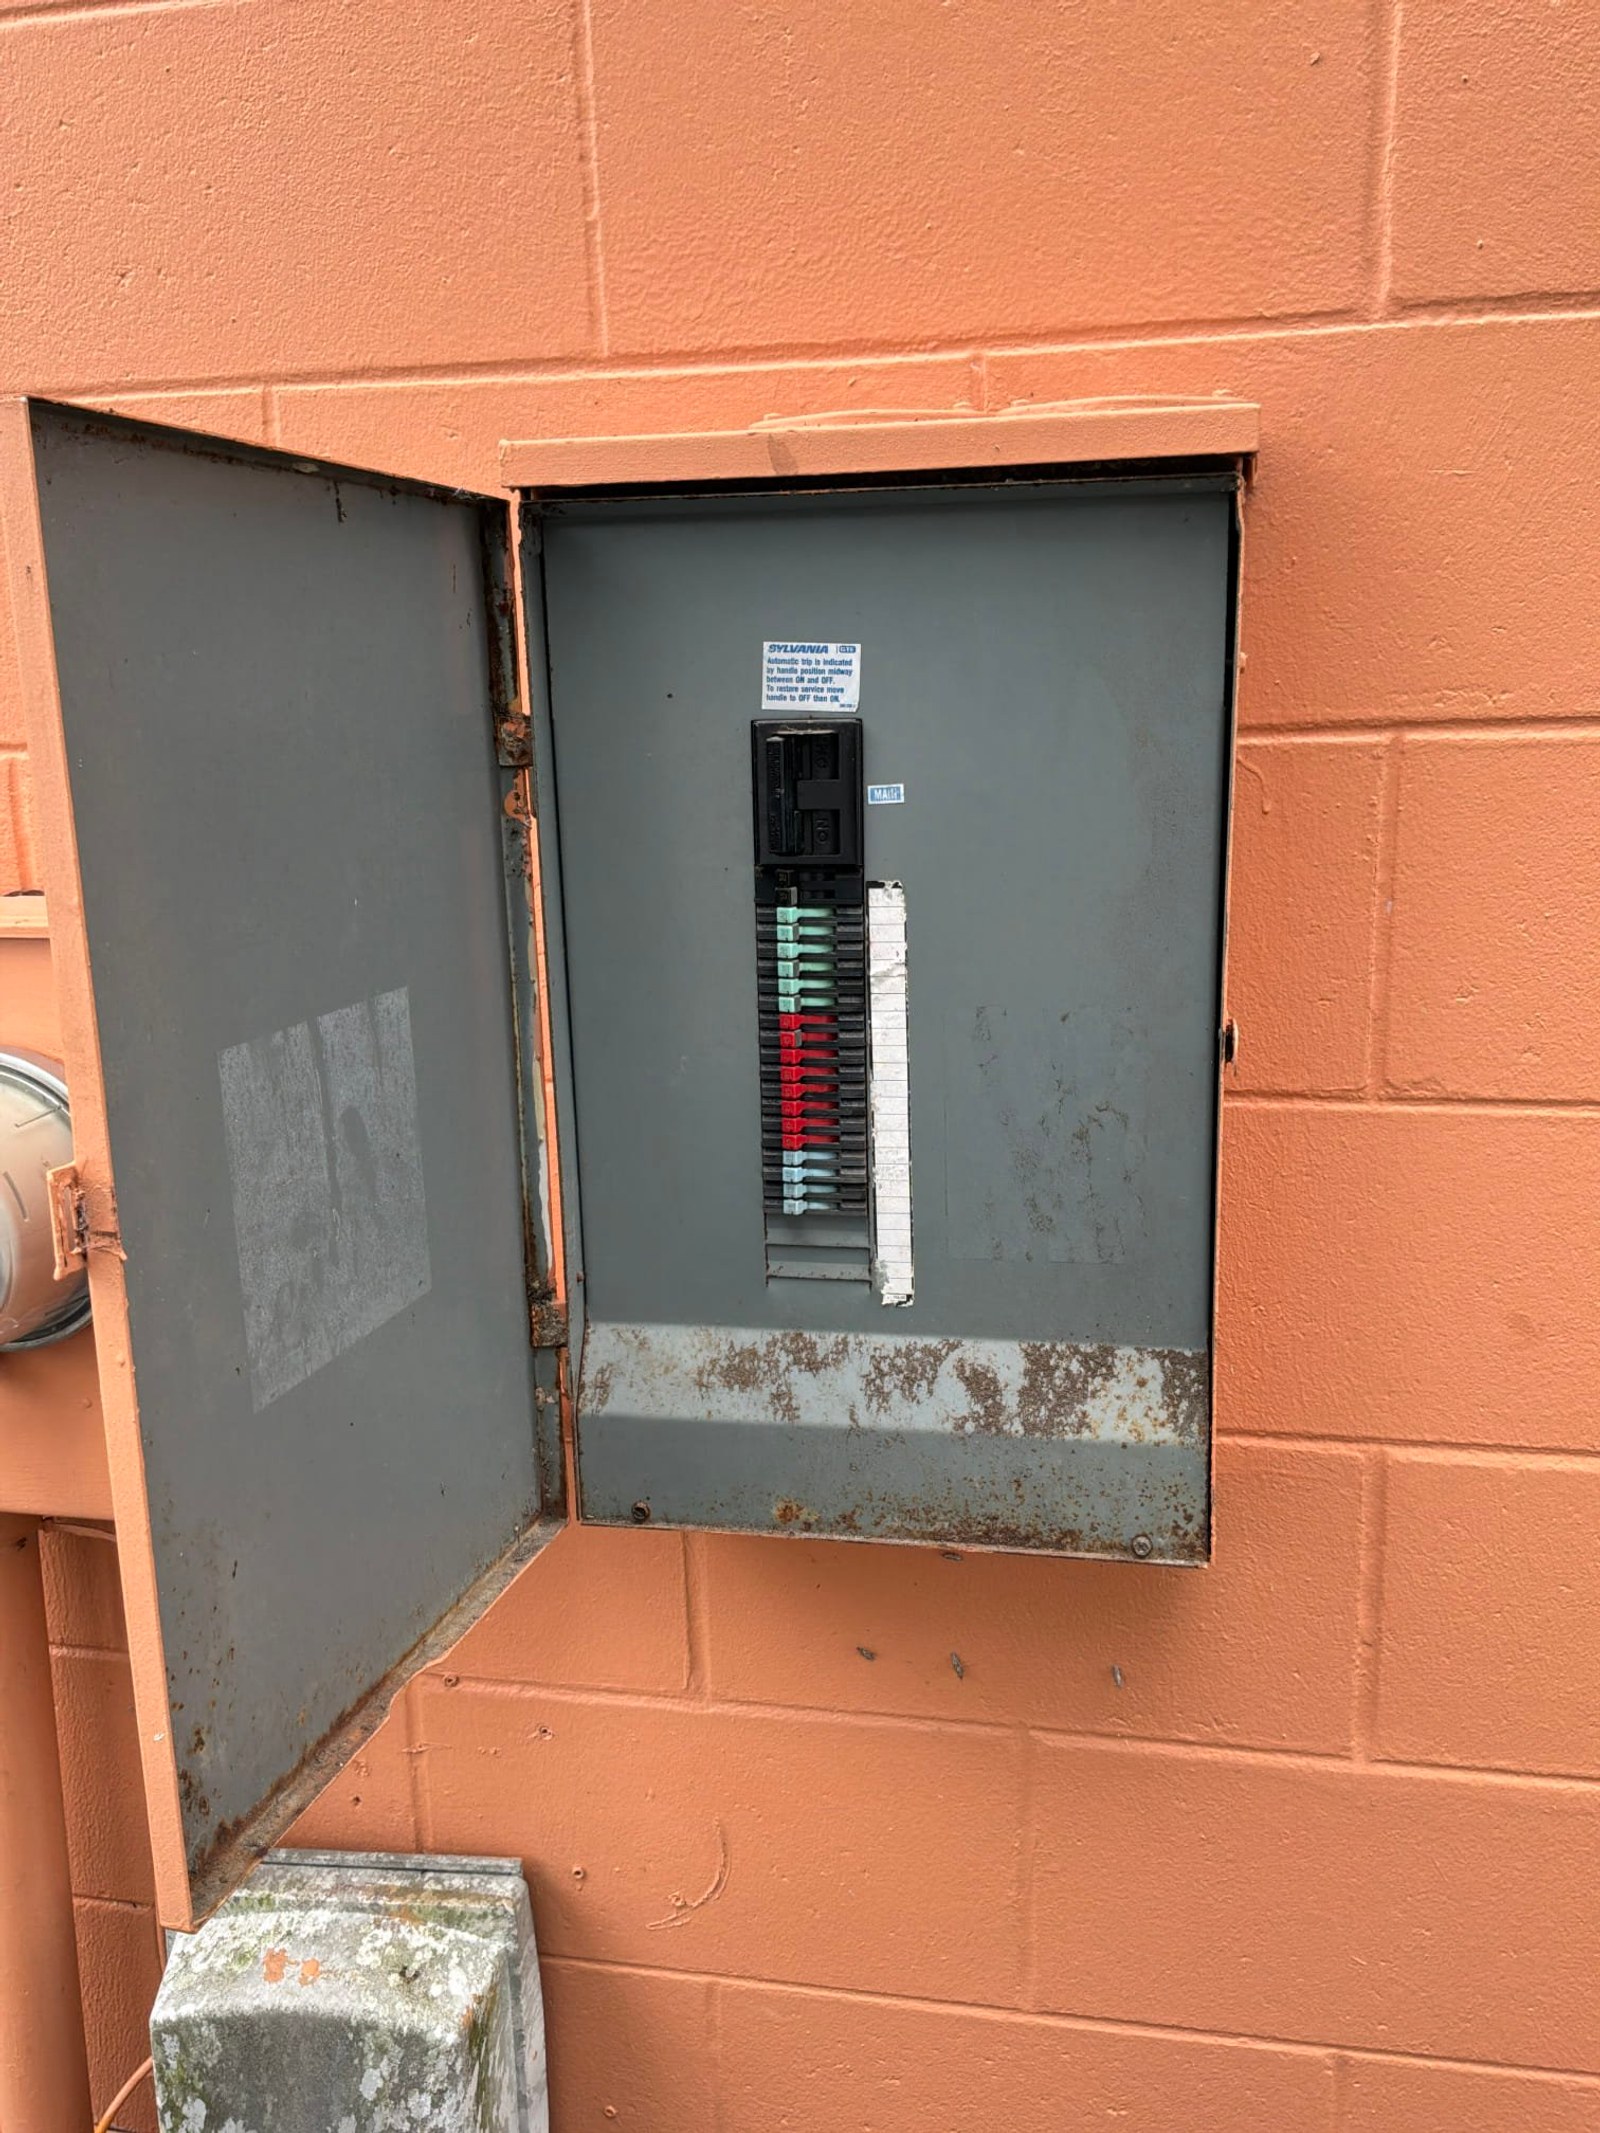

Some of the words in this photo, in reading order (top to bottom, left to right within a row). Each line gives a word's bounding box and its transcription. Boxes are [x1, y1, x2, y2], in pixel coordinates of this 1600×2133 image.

[768, 644, 829, 654] SYLVANIA
[801, 658, 813, 667] trip
[823, 659, 853, 667] indicated
[766, 667, 774, 676] by
[776, 667, 798, 675] handle
[800, 668, 826, 676] position
[828, 668, 853, 677] midway
[766, 676, 794, 684] between
[822, 676, 836, 684] OFF.
[766, 684, 774, 692] To
[776, 685, 798, 693] restore
[801, 686, 825, 694] service
[798, 694, 810, 702] OFF
